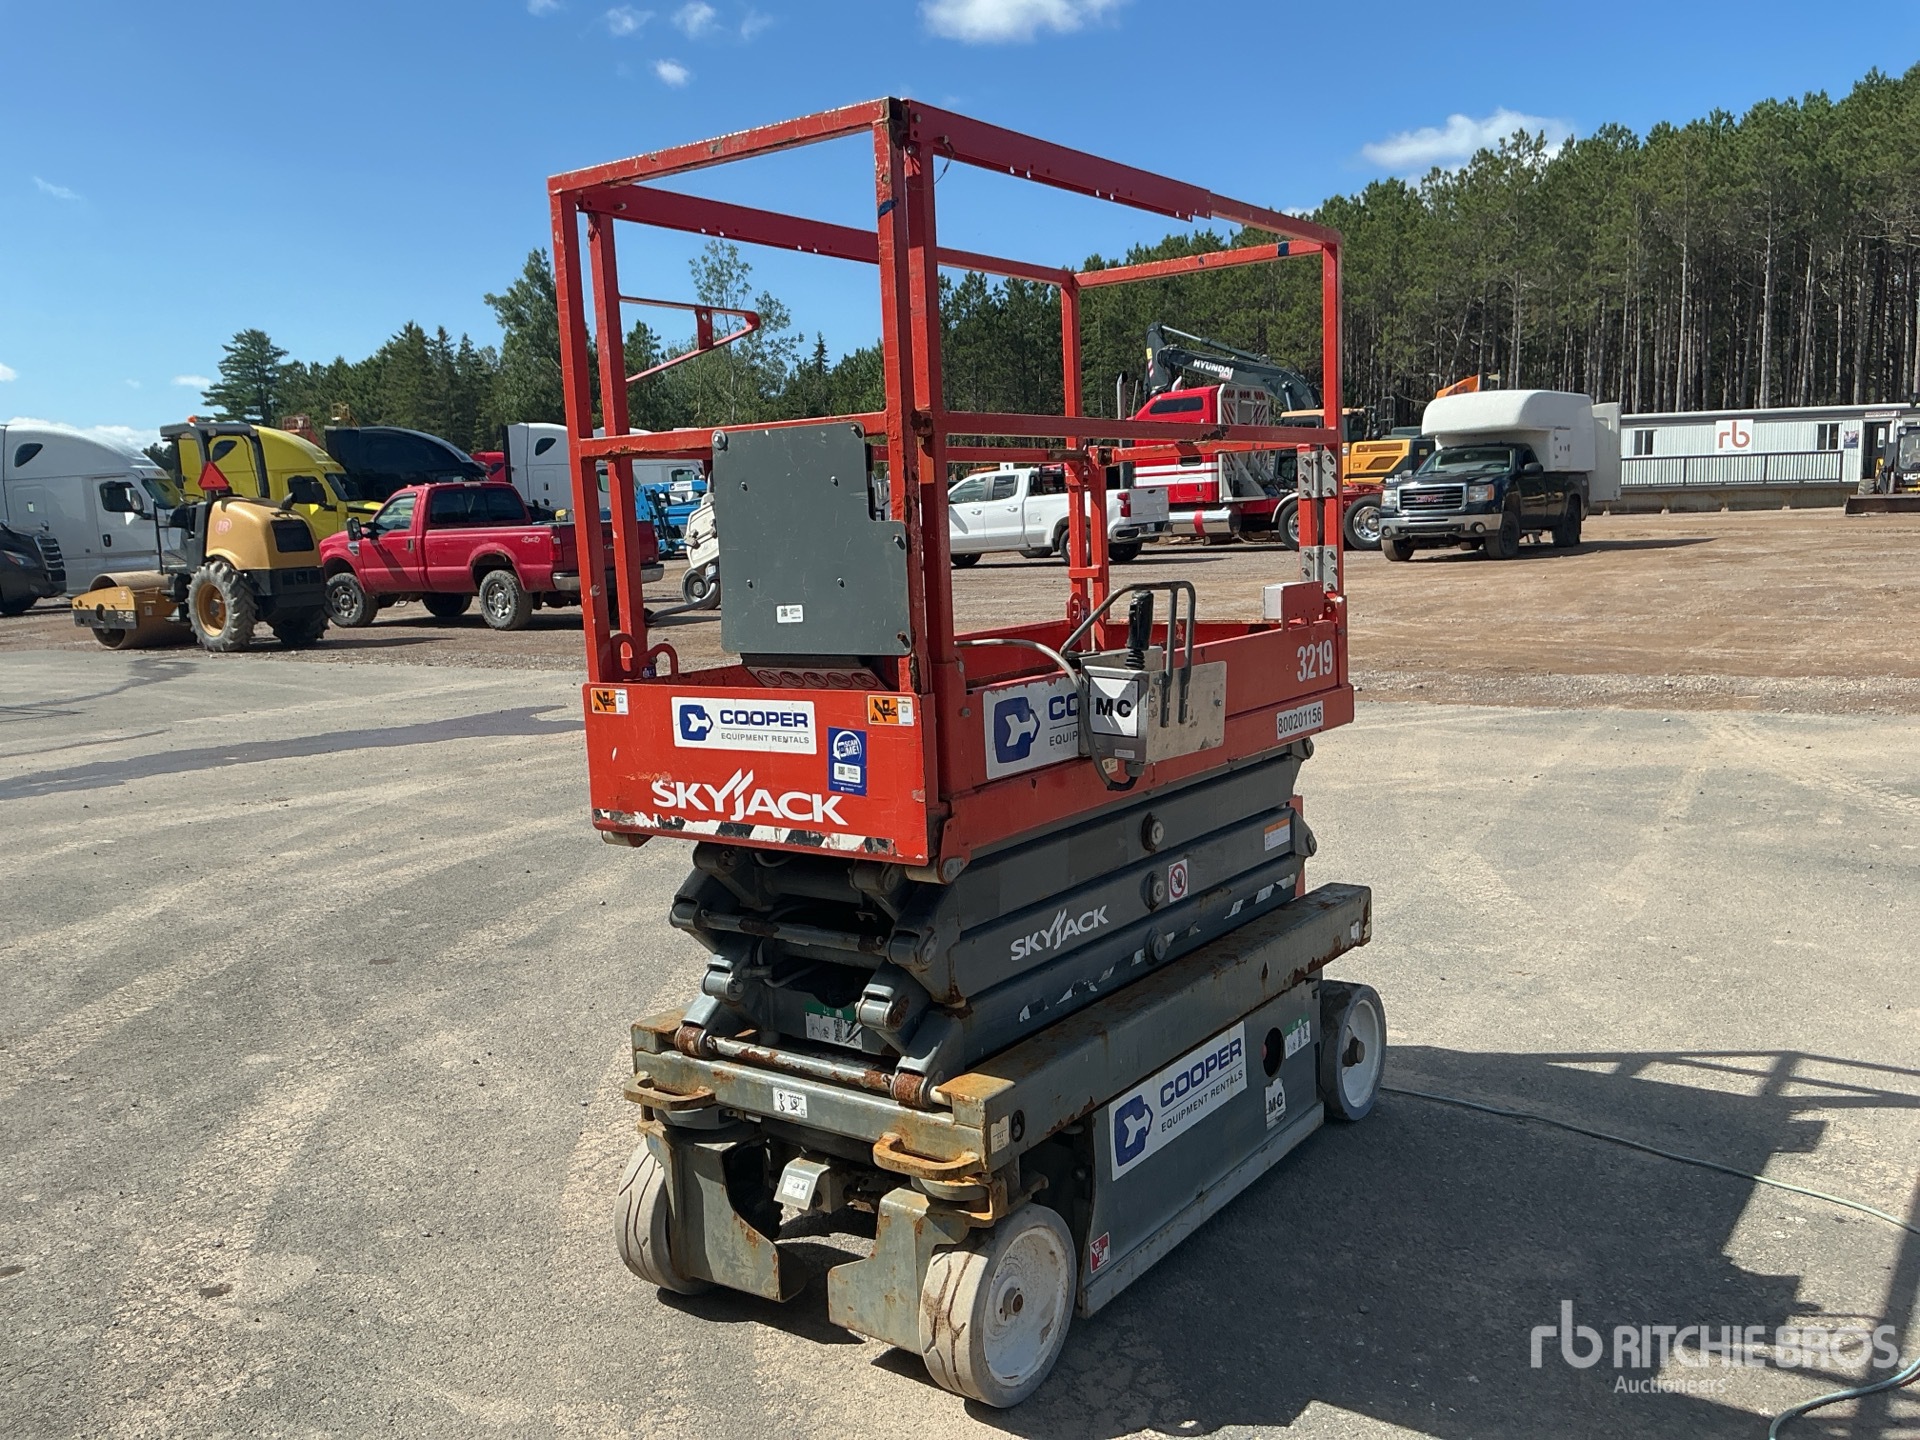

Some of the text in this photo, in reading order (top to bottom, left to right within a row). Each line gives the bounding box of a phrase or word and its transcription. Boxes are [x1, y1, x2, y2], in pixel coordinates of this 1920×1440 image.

[1193, 359, 1234, 376] HYUNDAI
[1718, 421, 1750, 448] rb
[1903, 473, 1920, 481] JC
[1297, 639, 1333, 682] 3219
[720, 709, 808, 728] COOPER
[1278, 706, 1322, 734] 800201156
[721, 733, 810, 744] EQUIPMENT RENTALS
[1050, 731, 1078, 746] EQUIP
[652, 768, 849, 825] SKYJACK
[1010, 905, 1109, 961] SKYJACK
[1160, 1038, 1242, 1108] COOPER
[1161, 1070, 1243, 1132] EQUIPMENT RENTALS
